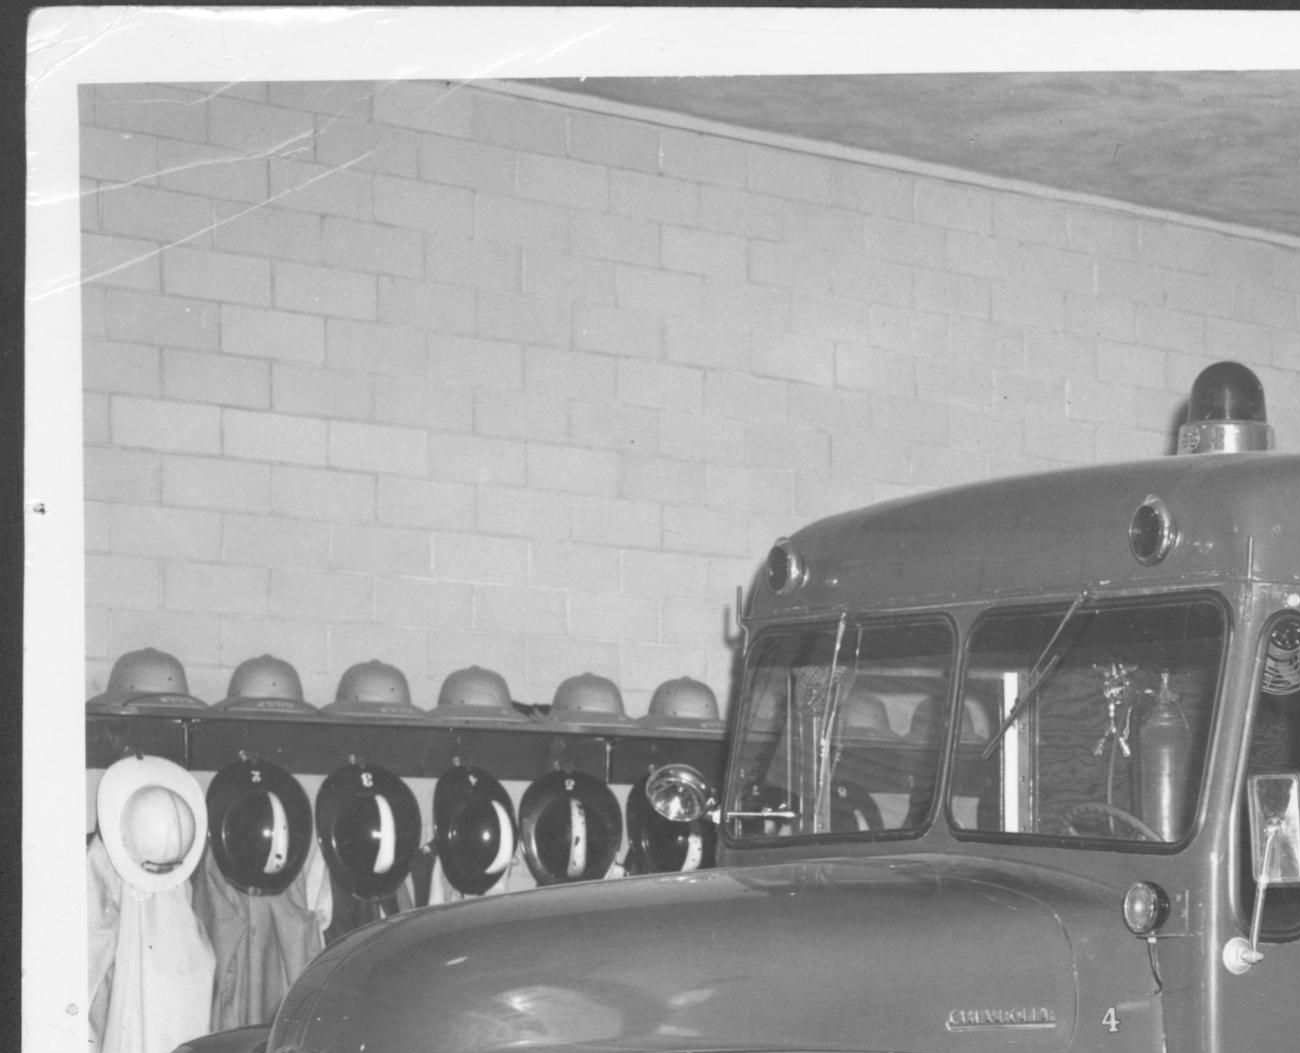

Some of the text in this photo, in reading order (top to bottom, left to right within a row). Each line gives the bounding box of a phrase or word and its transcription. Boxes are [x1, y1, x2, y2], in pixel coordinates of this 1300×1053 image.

[250, 769, 262, 783] 2
[360, 771, 374, 788] 3
[1101, 1006, 1121, 1033] 4
